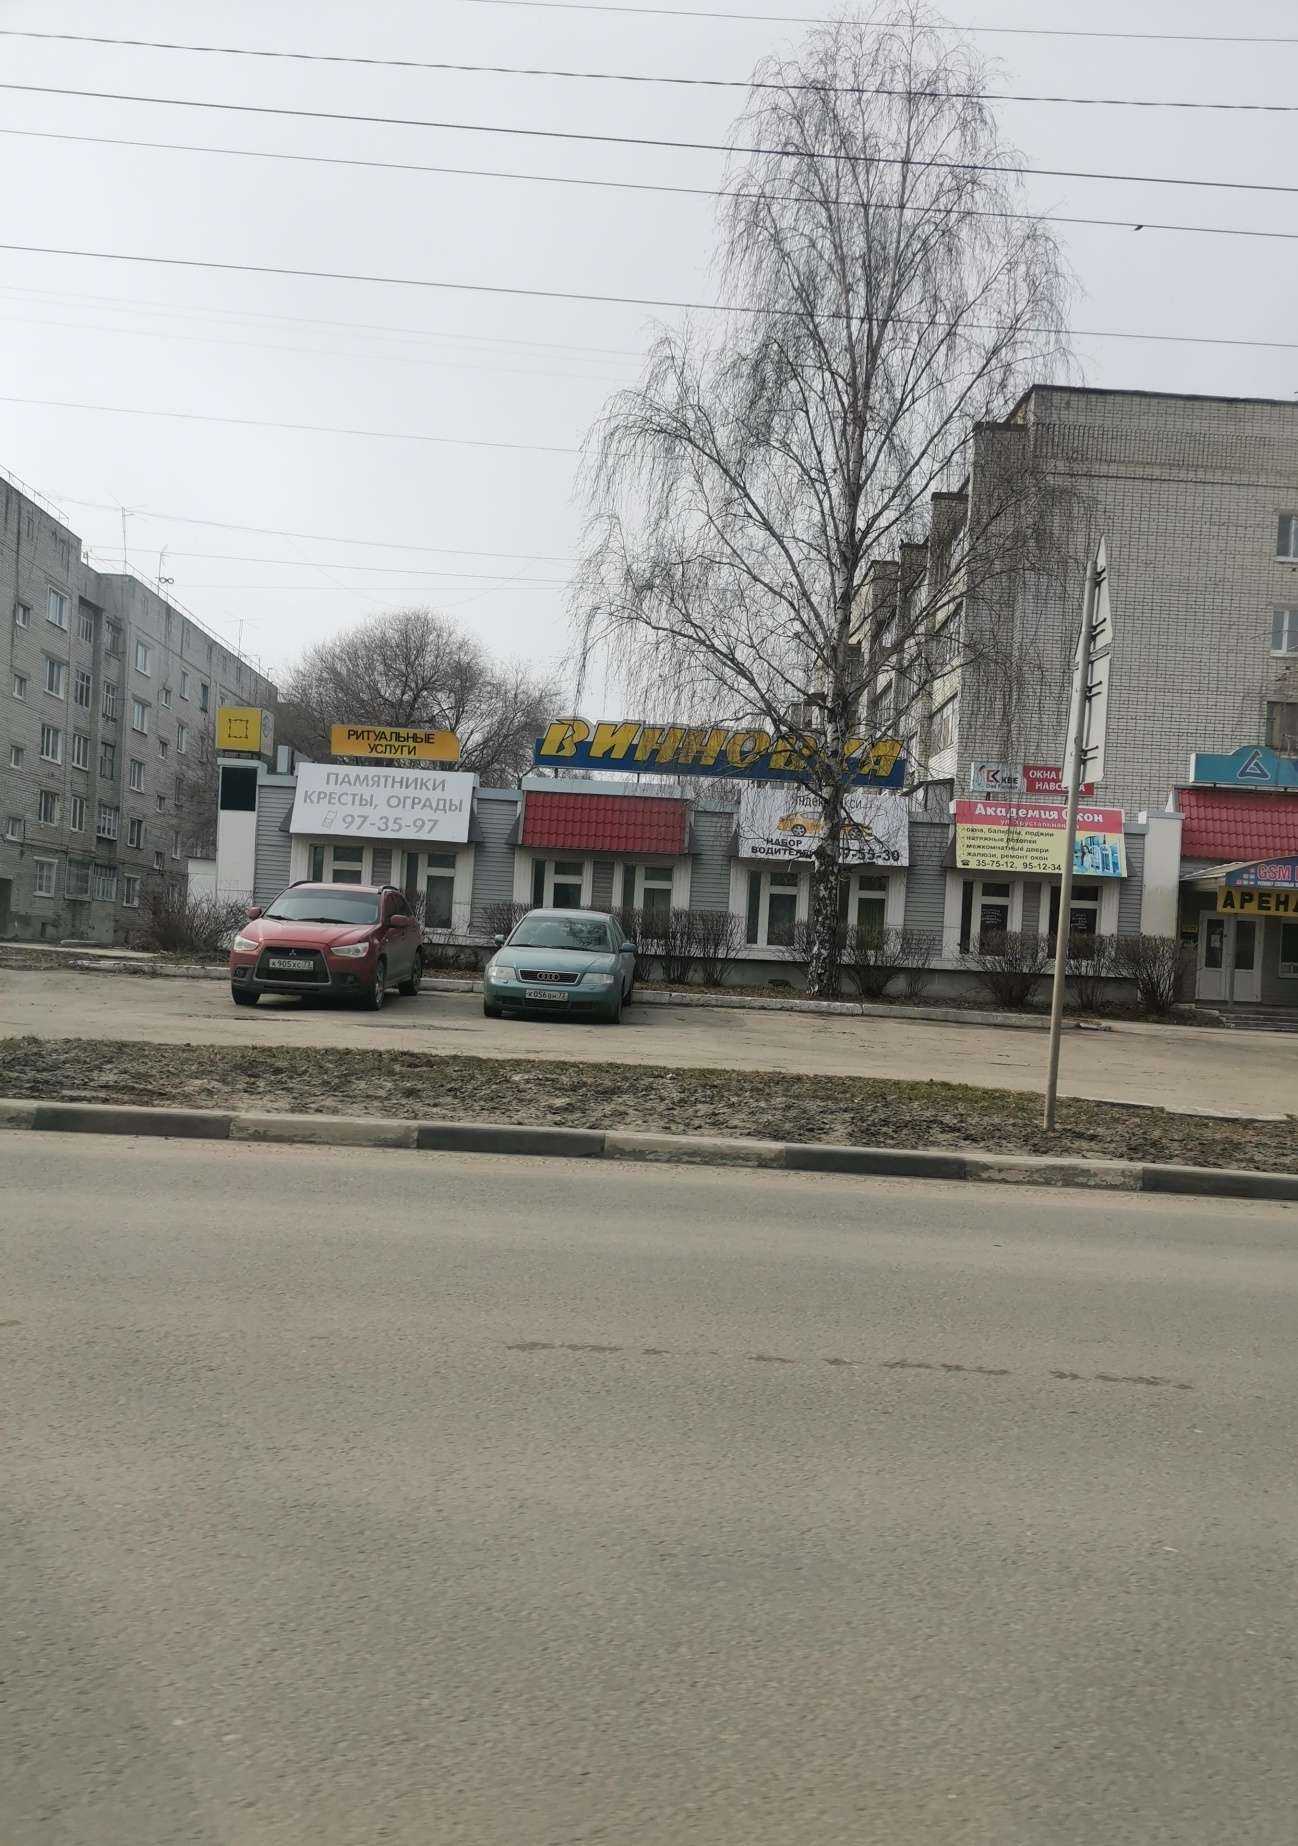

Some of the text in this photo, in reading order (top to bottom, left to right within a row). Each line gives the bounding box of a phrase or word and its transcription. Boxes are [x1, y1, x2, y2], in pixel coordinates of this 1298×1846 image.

[347, 729, 436, 745] РИТУАЛЬНЫЕ
[368, 743, 417, 756] УСЛУГИ
[325, 772, 447, 792] ПАМЯТНИКИ
[1029, 769, 1057, 779] ОКНА
[1035, 781, 1086, 792] НАВСЕА
[303, 790, 463, 814] КРЕСТЫ, ОГРАДЫ
[975, 804, 1058, 820] Академия
[341, 813, 439, 835] 97-35-97
[766, 837, 803, 848] НАБОР
[975, 859, 1062, 872] 35-75-12, 95-12-34
[1257, 864, 1292, 880] GSM
